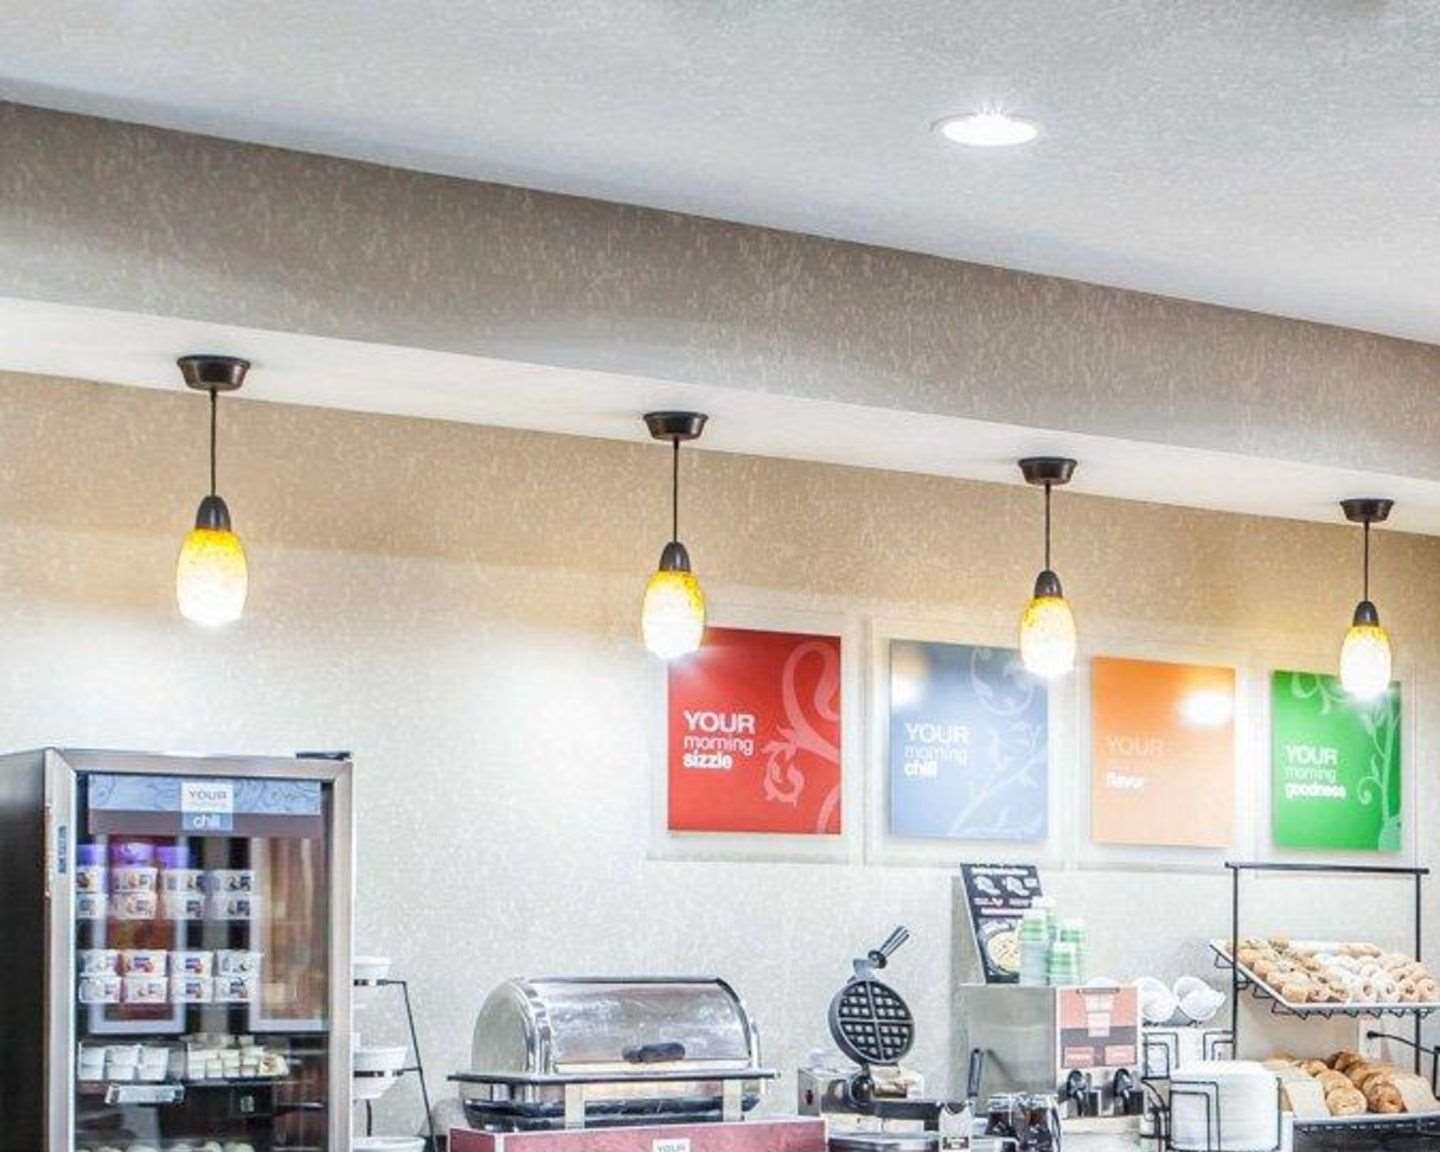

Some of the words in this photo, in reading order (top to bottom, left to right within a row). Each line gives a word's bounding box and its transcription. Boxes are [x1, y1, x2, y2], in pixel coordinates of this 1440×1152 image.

[683, 710, 755, 734] YOUR
[904, 722, 968, 743] YOUR
[684, 736, 753, 756] morning
[1105, 736, 1165, 756] YOUR
[1285, 745, 1337, 764] YOUR
[683, 751, 733, 769] sizzle
[904, 745, 967, 768] morning
[904, 760, 937, 777] chill
[1285, 767, 1336, 784] morning
[188, 790, 228, 801] YOUR
[1285, 782, 1346, 799] goodness
[192, 814, 221, 829] chill
